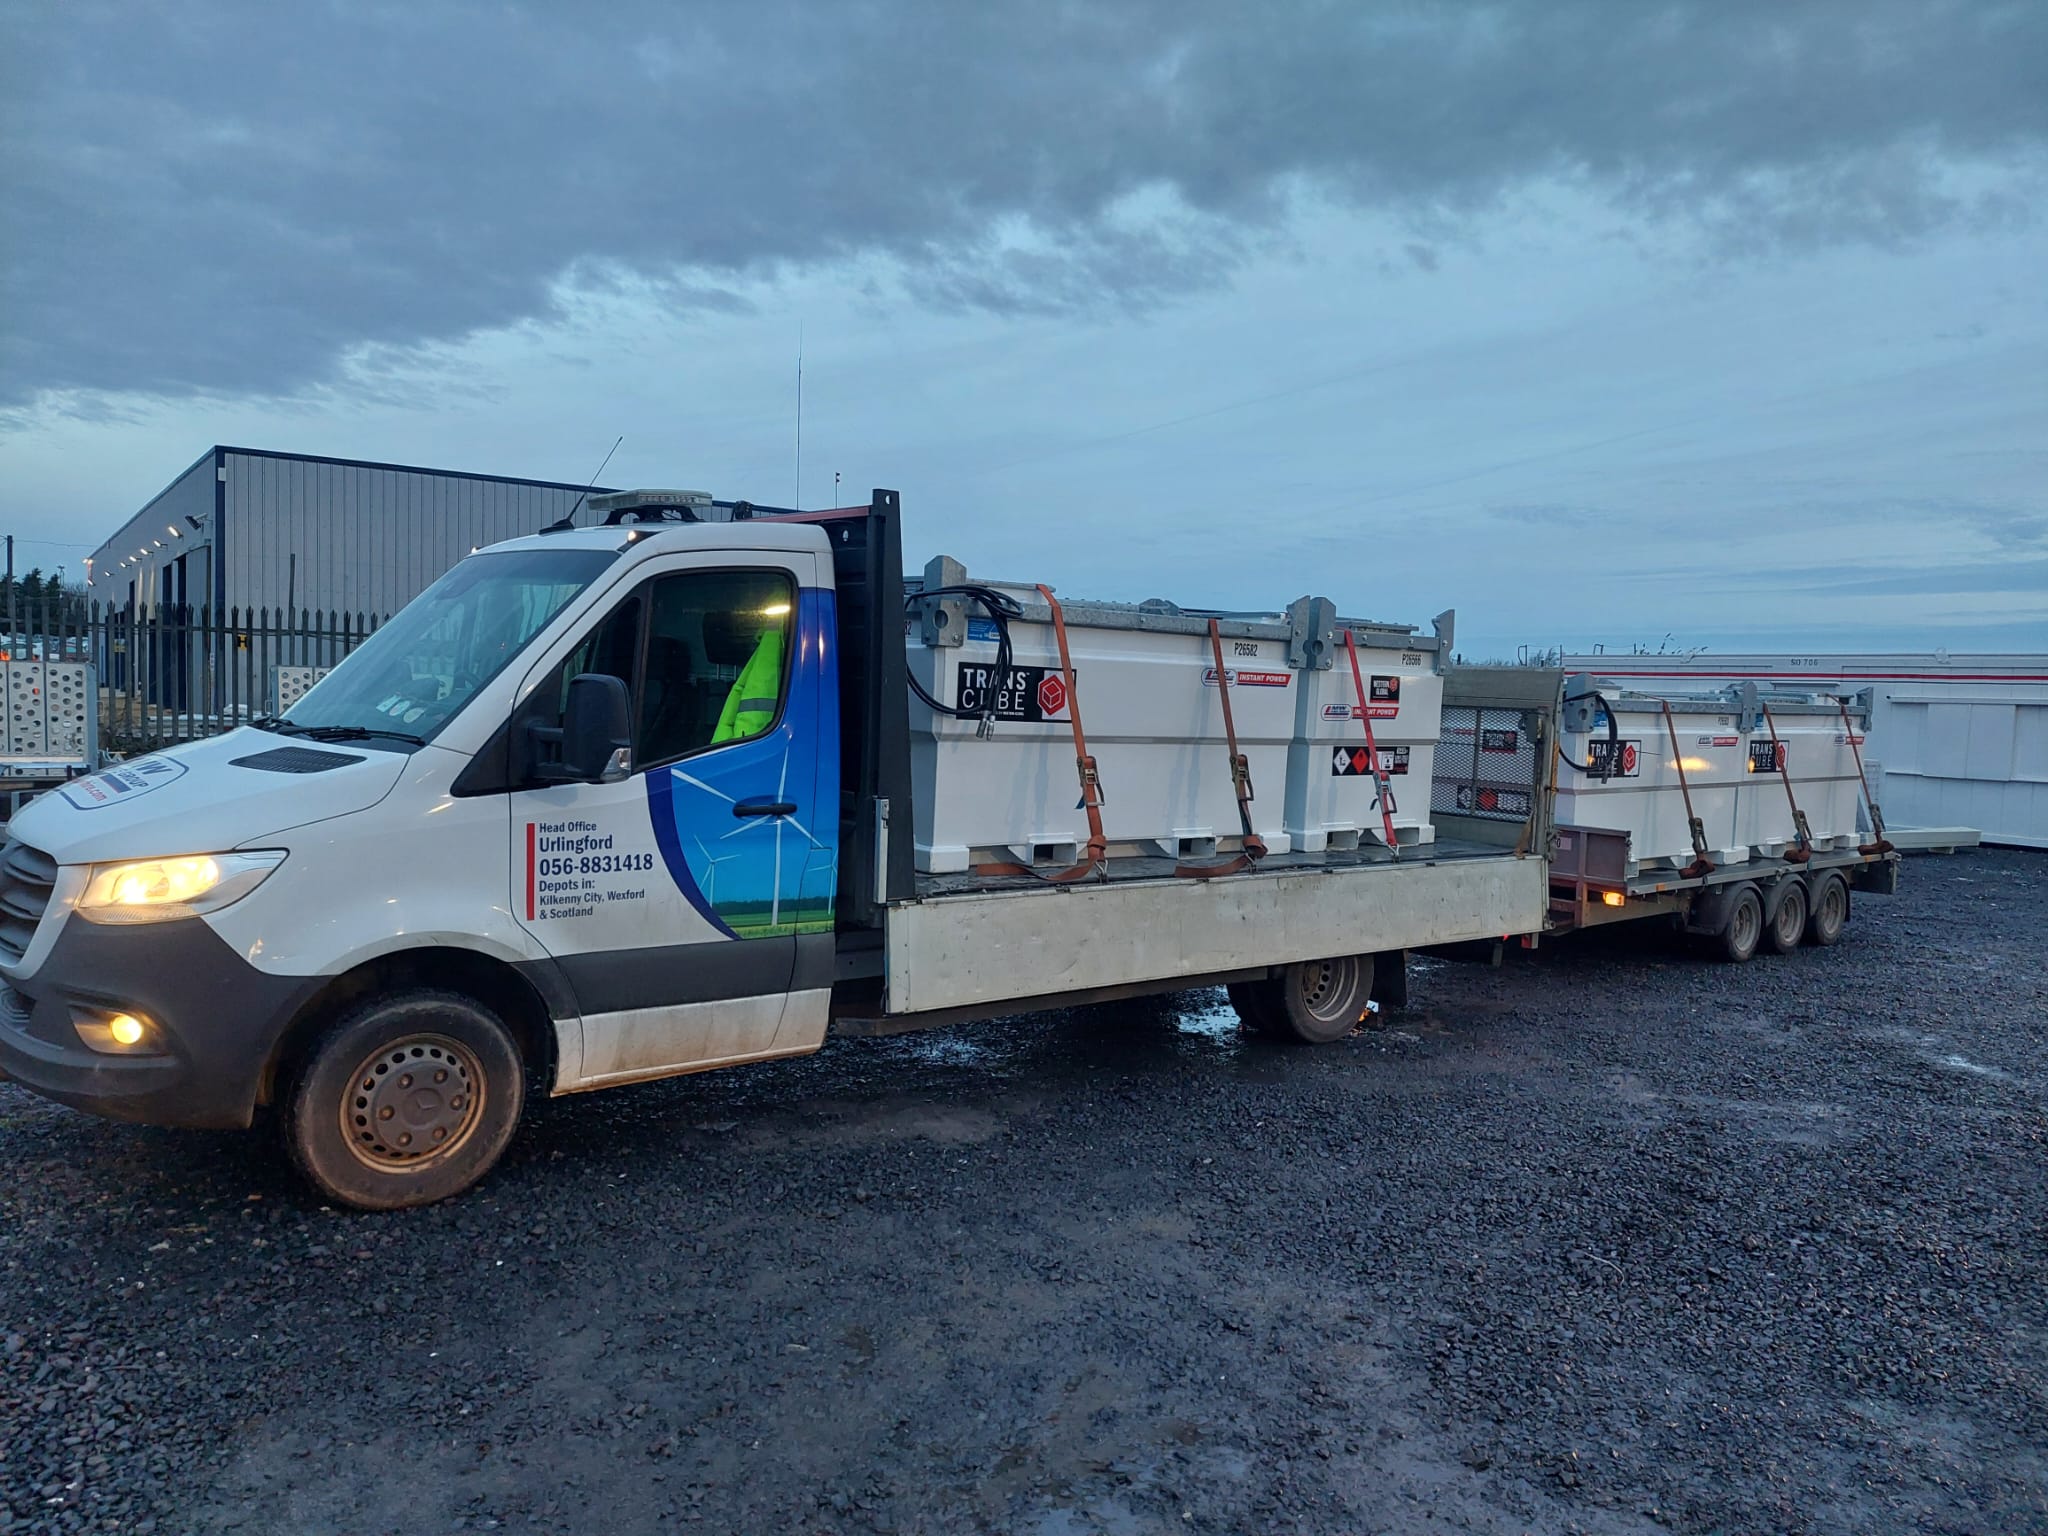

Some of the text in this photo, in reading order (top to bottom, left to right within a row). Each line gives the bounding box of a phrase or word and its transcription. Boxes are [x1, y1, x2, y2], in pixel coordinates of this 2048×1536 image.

[1234, 642, 1258, 657] P26582
[1590, 743, 1620, 757] TRAS
[1751, 743, 1773, 755] TRANS
[539, 821, 597, 833] Head Office
[539, 834, 613, 854] Urlingford
[539, 853, 653, 876] 056-8831418
[539, 878, 596, 893] Depots in:
[539, 888, 645, 906] Kilkenny City, Wexford
[539, 906, 593, 919] & Scotland
